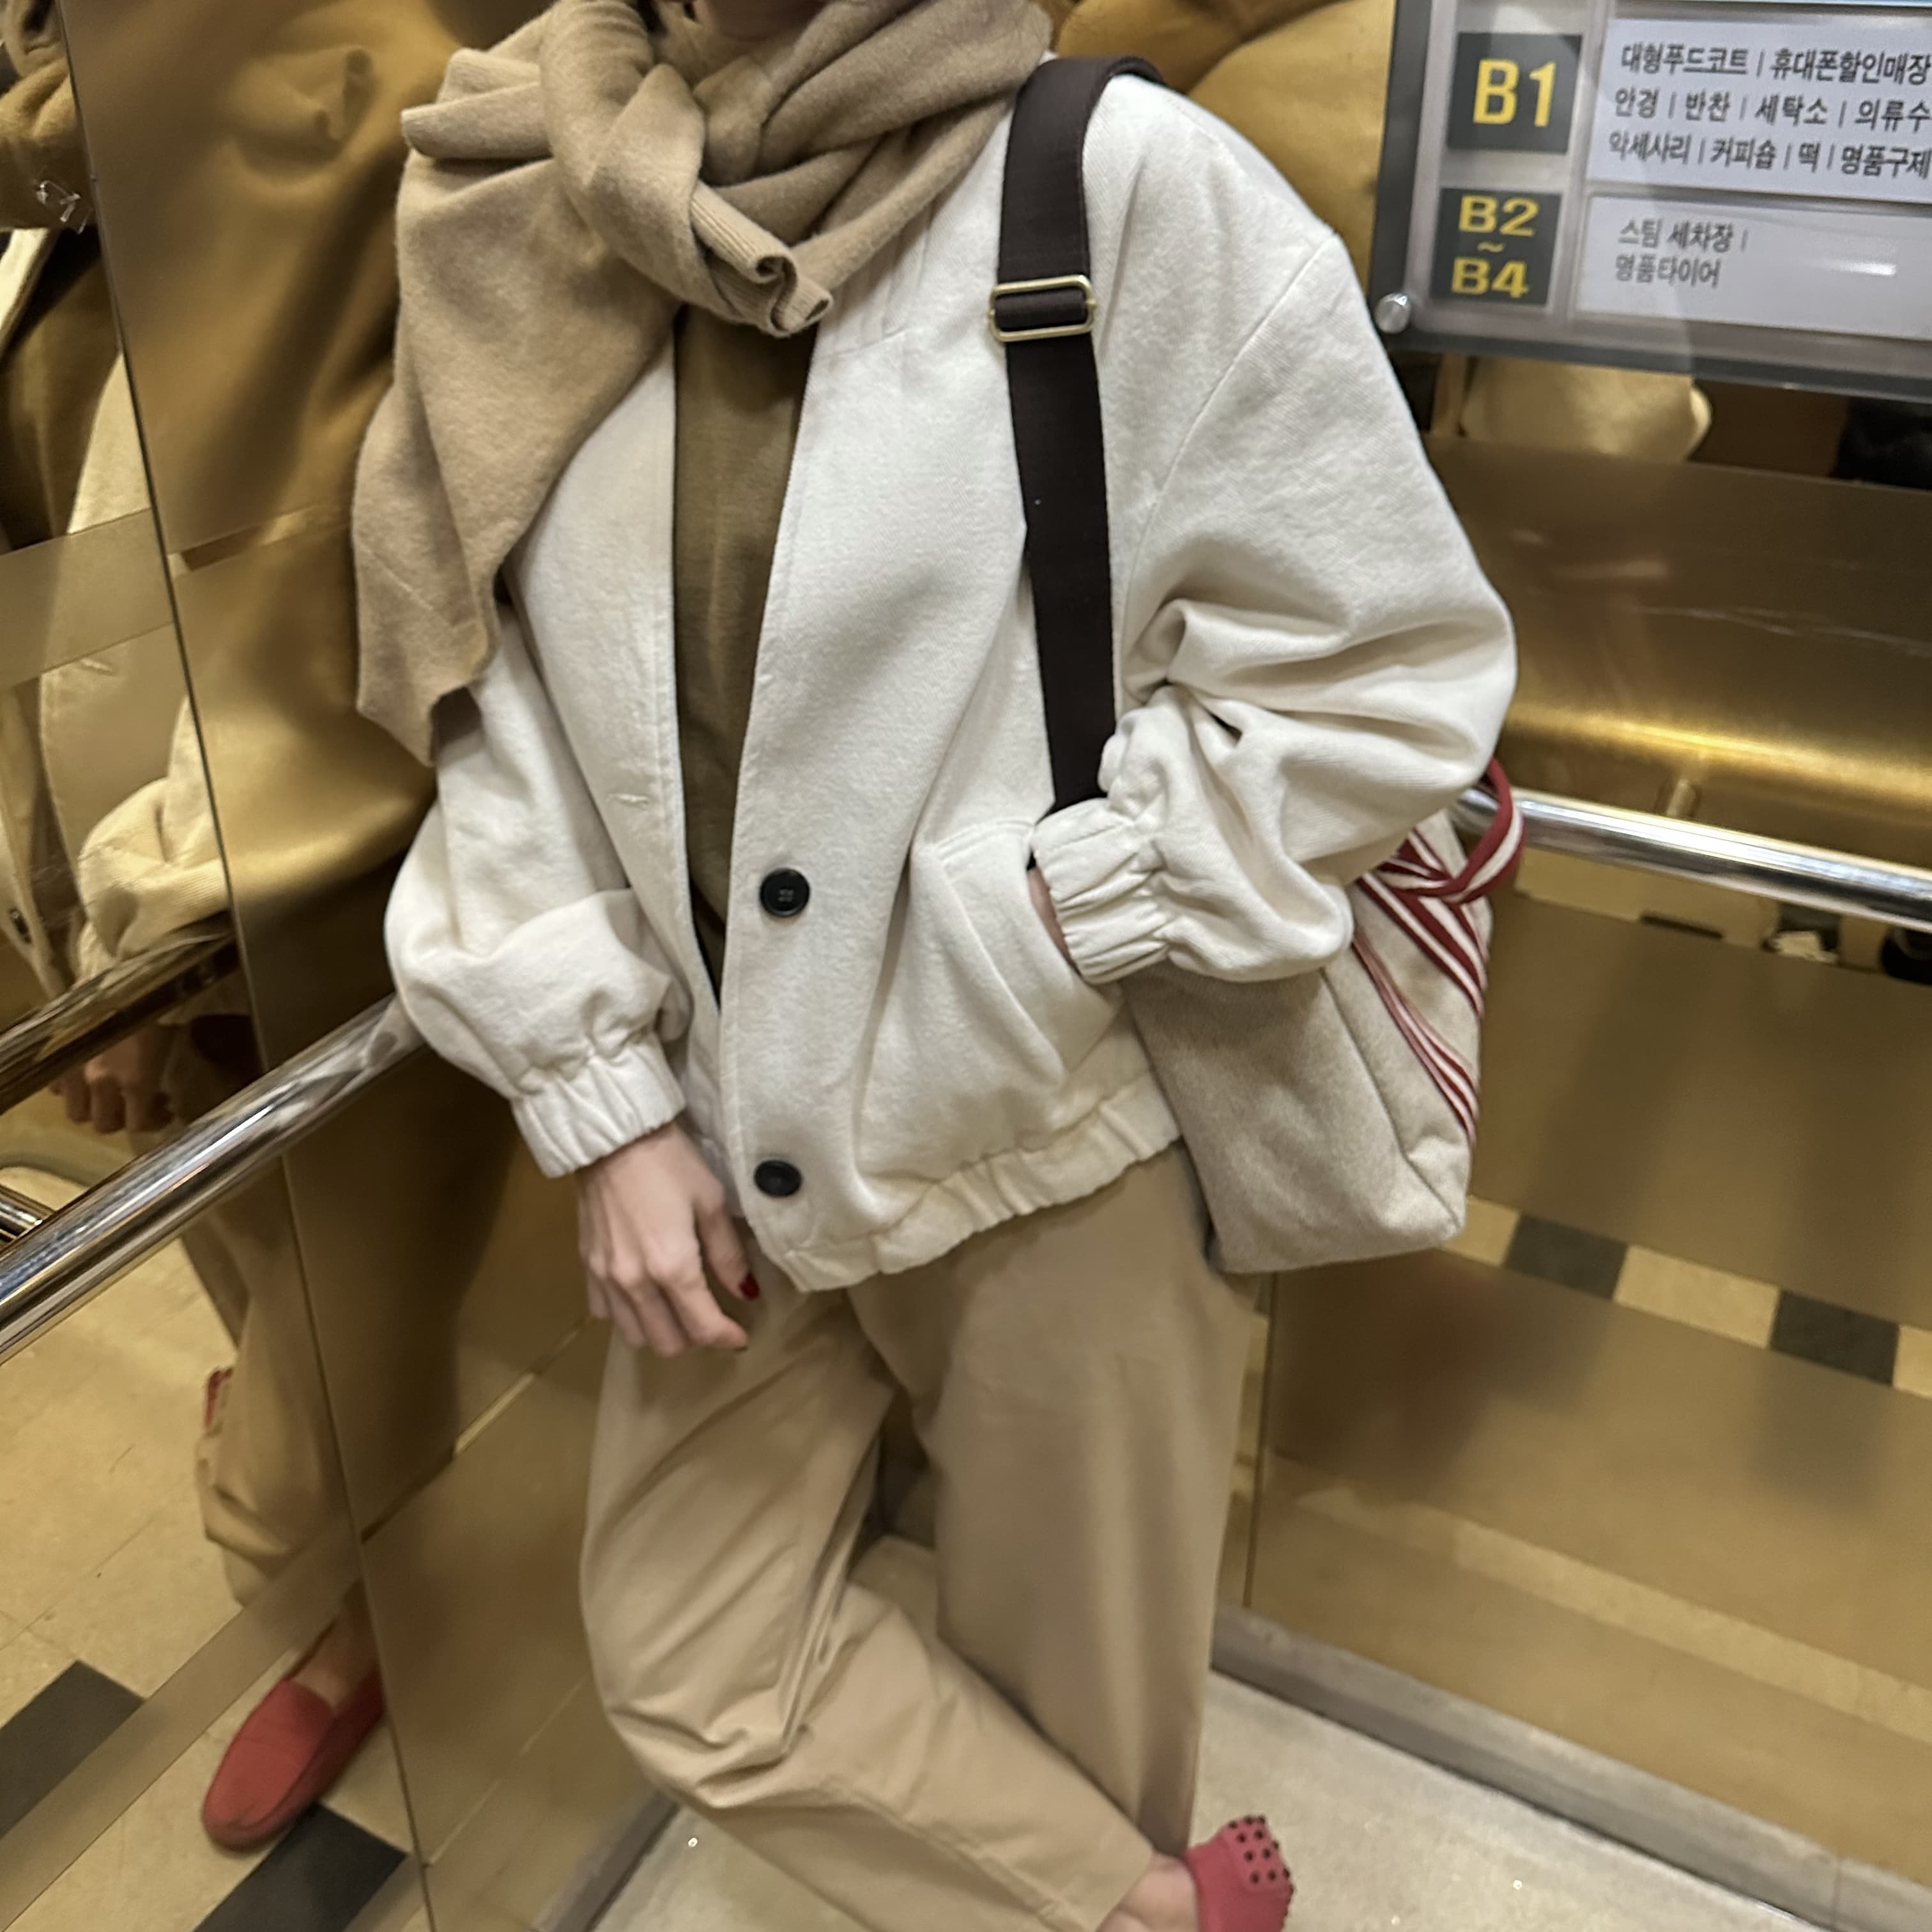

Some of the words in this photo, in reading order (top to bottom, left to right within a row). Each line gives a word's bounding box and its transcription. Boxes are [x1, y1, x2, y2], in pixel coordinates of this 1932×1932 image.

[1621, 42, 1749, 76] 대형푸드코트
[1770, 48, 1931, 86] 휴대폰할인매장
[1473, 58, 1557, 128] B1
[1614, 87, 1660, 119] 안경
[1685, 91, 1731, 123] 반찬
[1755, 93, 1828, 127] 세탁소
[1710, 137, 1777, 170] 커피숍
[1798, 141, 1821, 174] 떡
[1841, 142, 1932, 180] 명품구제
[1459, 194, 1540, 238] B2
[1618, 218, 1663, 249] 스팀
[1666, 220, 1734, 254] 세차장
[1450, 256, 1529, 299] B4
[1614, 254, 1722, 289] 명품타이어
